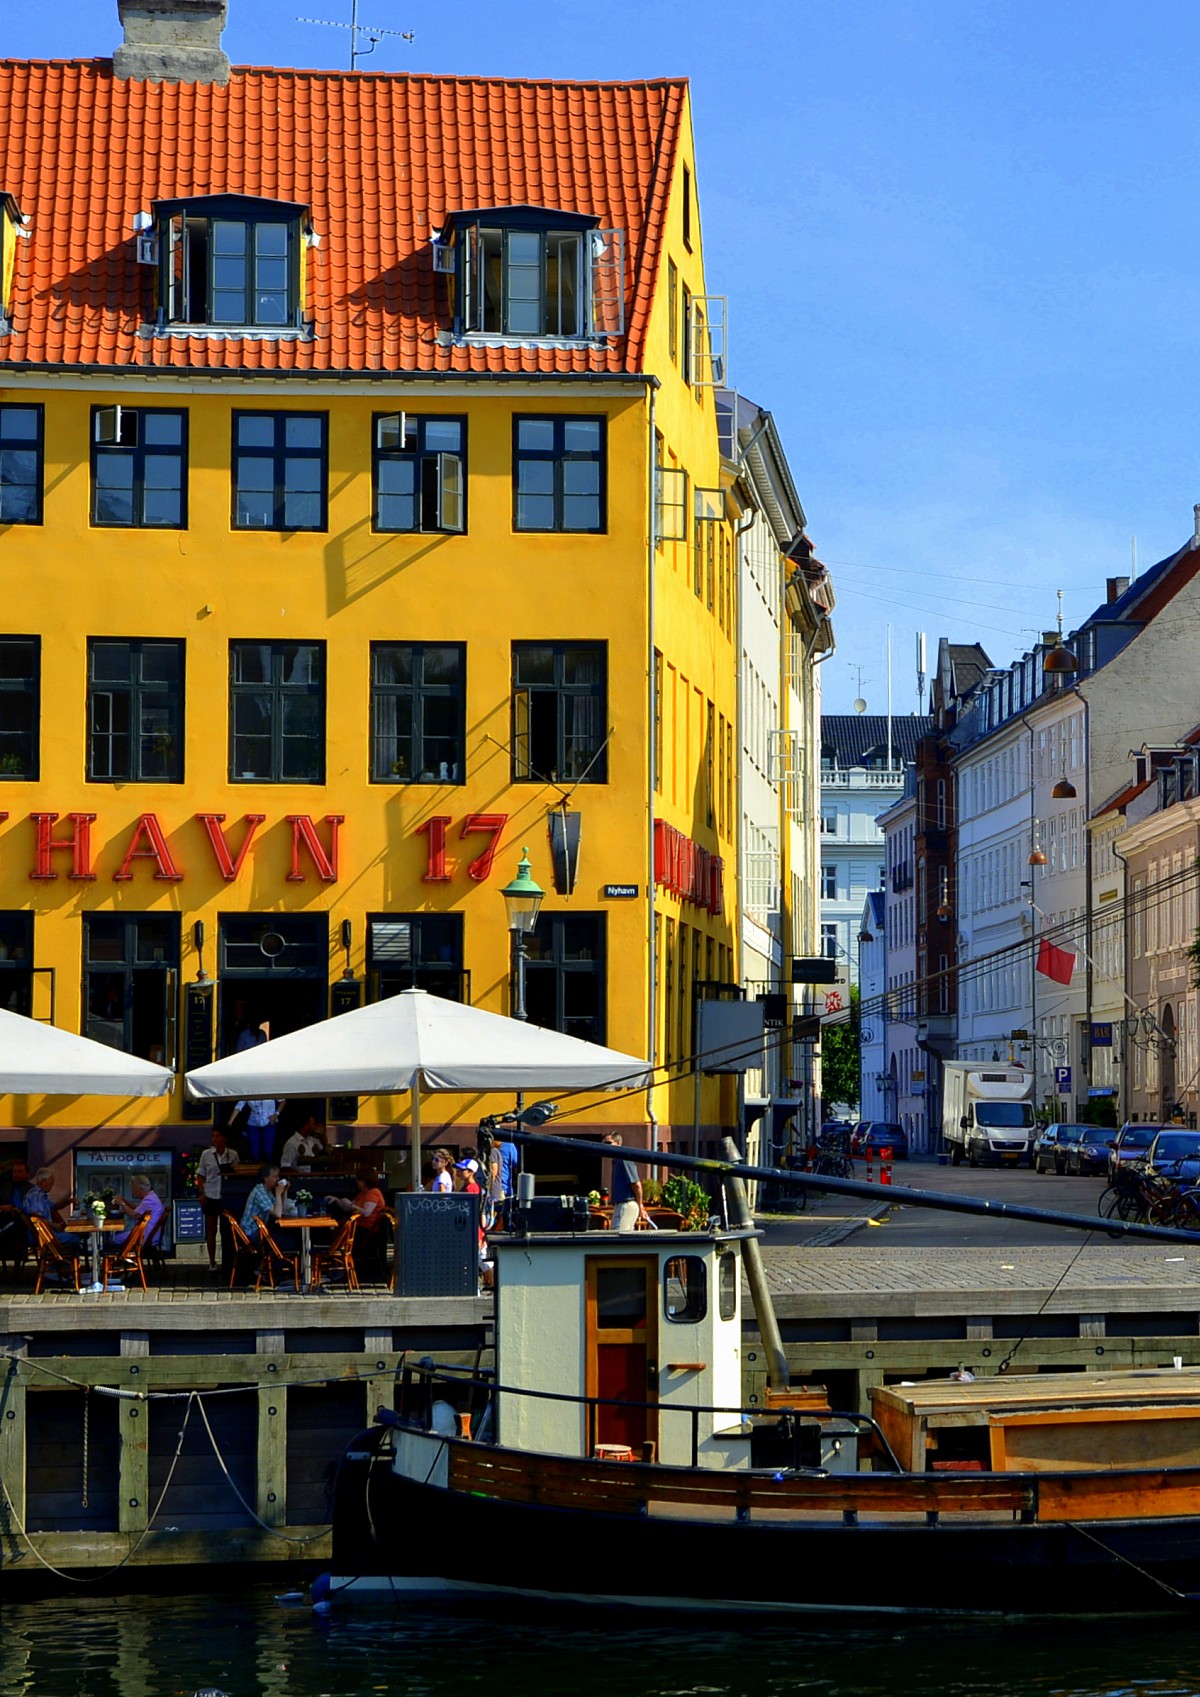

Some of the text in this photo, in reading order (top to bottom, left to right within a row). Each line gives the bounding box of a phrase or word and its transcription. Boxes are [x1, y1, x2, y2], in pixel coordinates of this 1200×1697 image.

[0, 811, 509, 882] HAVN 17
[607, 886, 636, 896] Nyhavn
[763, 1019, 784, 1027] NTIK
[1094, 1027, 1109, 1038] BAR
[1058, 1068, 1068, 1082] P
[88, 1152, 161, 1163] TATTOO OLE
